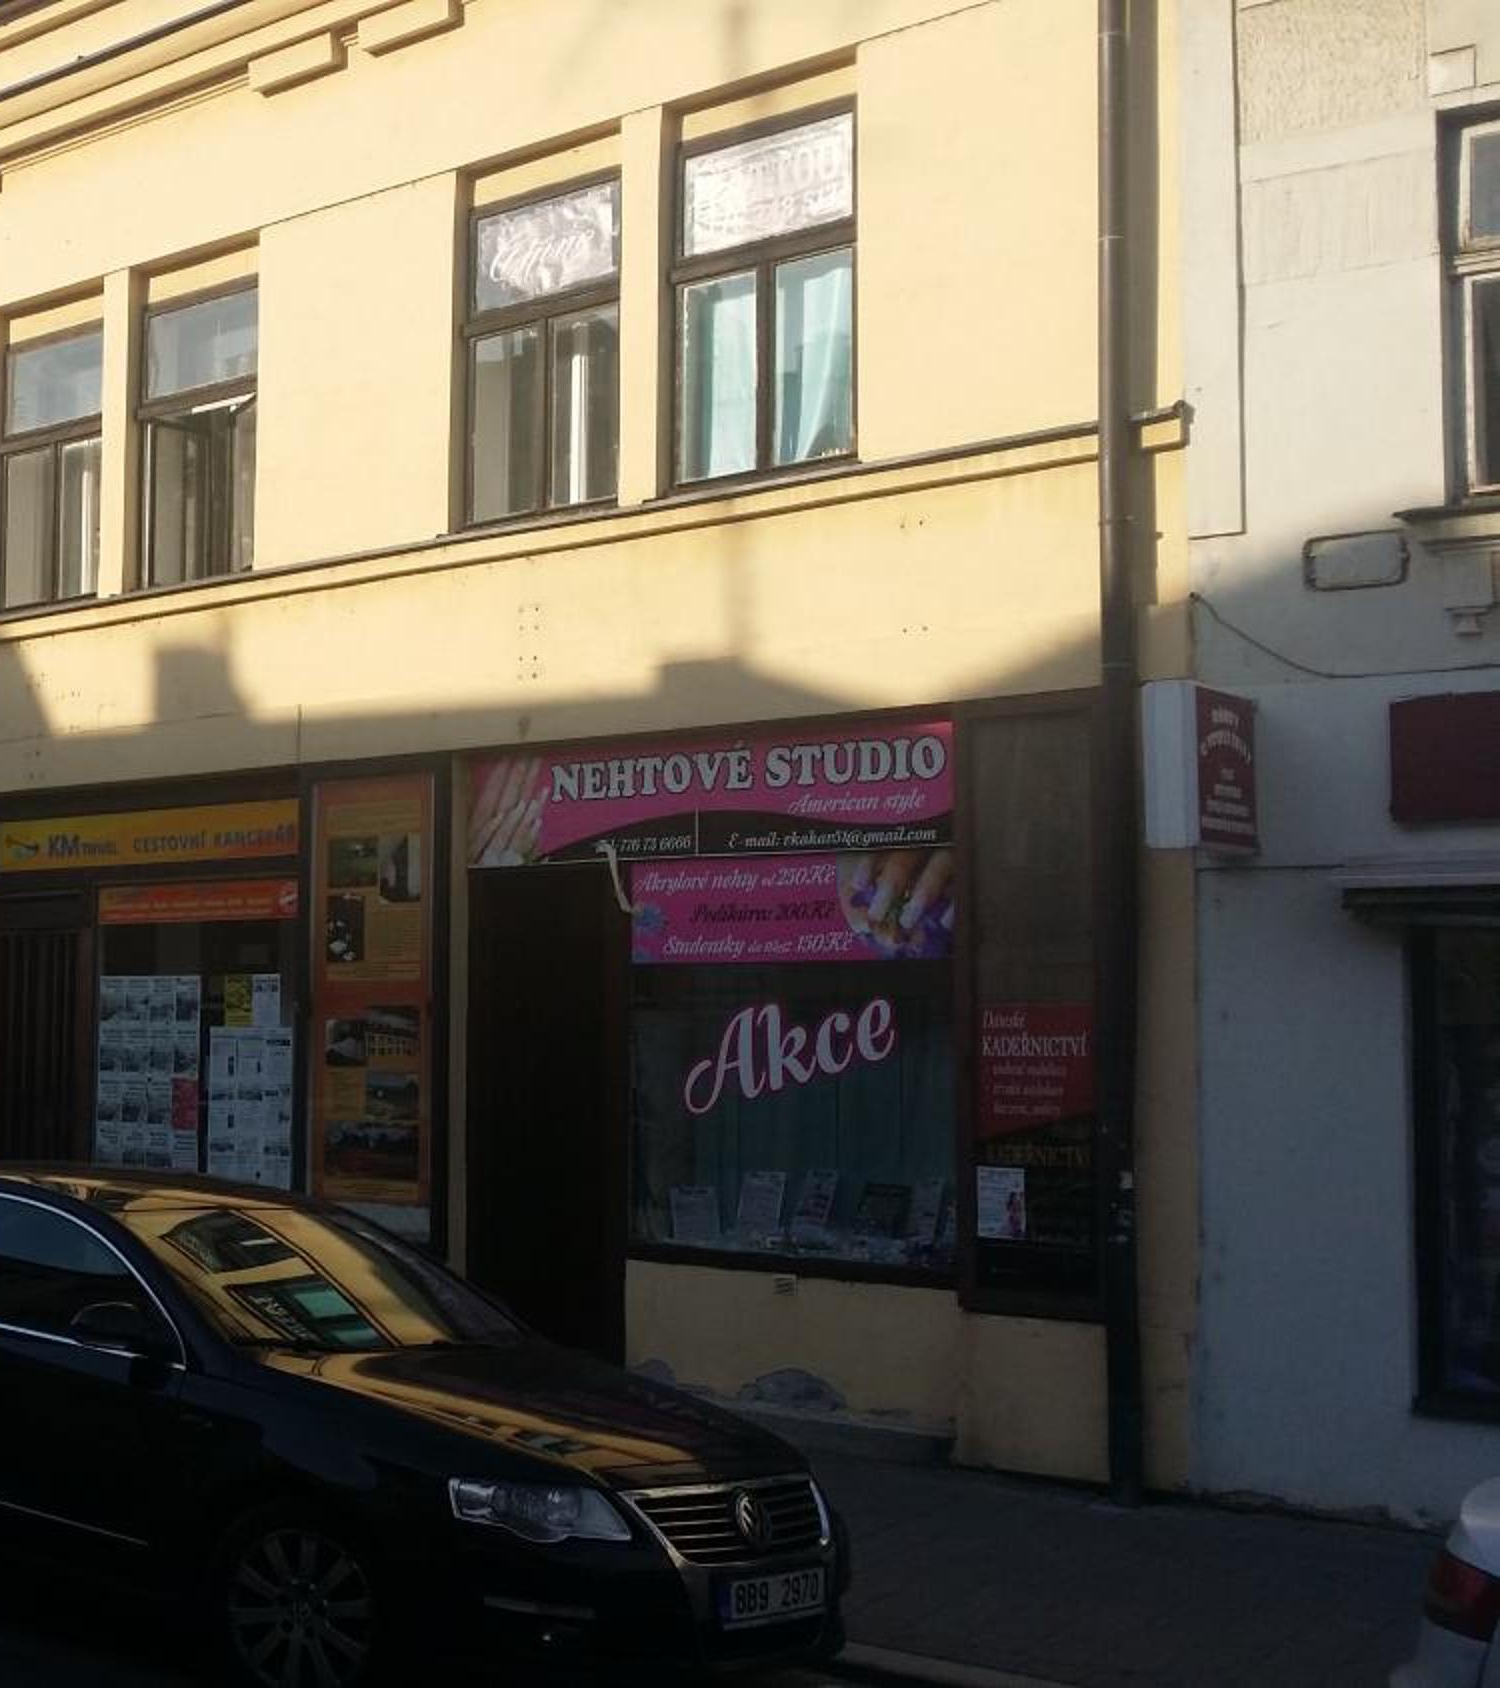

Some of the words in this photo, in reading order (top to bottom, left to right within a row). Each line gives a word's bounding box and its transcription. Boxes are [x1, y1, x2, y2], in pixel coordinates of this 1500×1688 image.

[551, 740, 754, 801] NEHTOVÉ
[765, 736, 946, 787] STUDIO
[787, 790, 880, 814] American
[883, 788, 925, 818] style
[49, 833, 81, 857] KM
[133, 829, 206, 854] CESTOVNÍ
[633, 868, 709, 896] Akrylové
[711, 868, 758, 894] nehty
[663, 934, 744, 959] Studentky
[684, 998, 896, 1114] Akce
[982, 1030, 1088, 1056] KADEŘNICTVÍ
[781, 1572, 819, 1606] 2970
